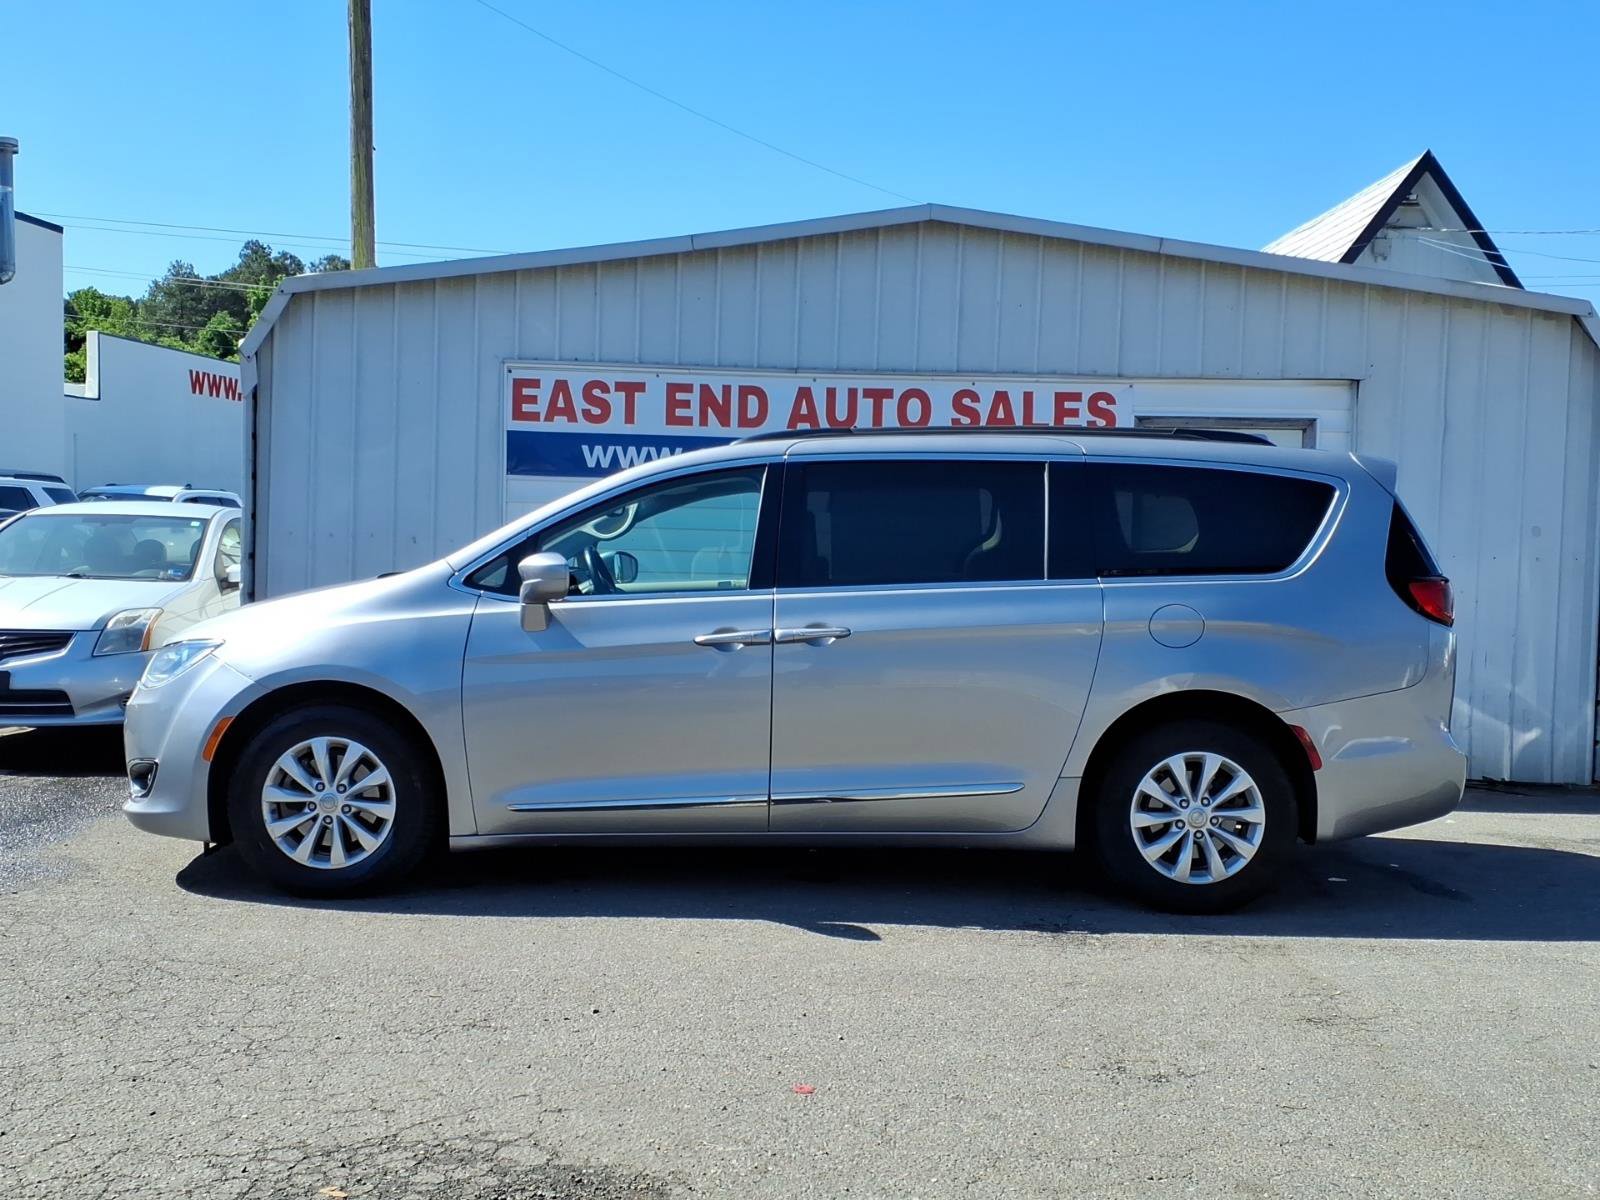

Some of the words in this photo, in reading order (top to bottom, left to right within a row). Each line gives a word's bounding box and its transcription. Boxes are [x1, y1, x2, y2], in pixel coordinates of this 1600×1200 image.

[511, 377, 647, 426] EAST
[665, 382, 769, 428] END
[786, 386, 932, 430] AUTO
[951, 389, 1117, 429] SALES
